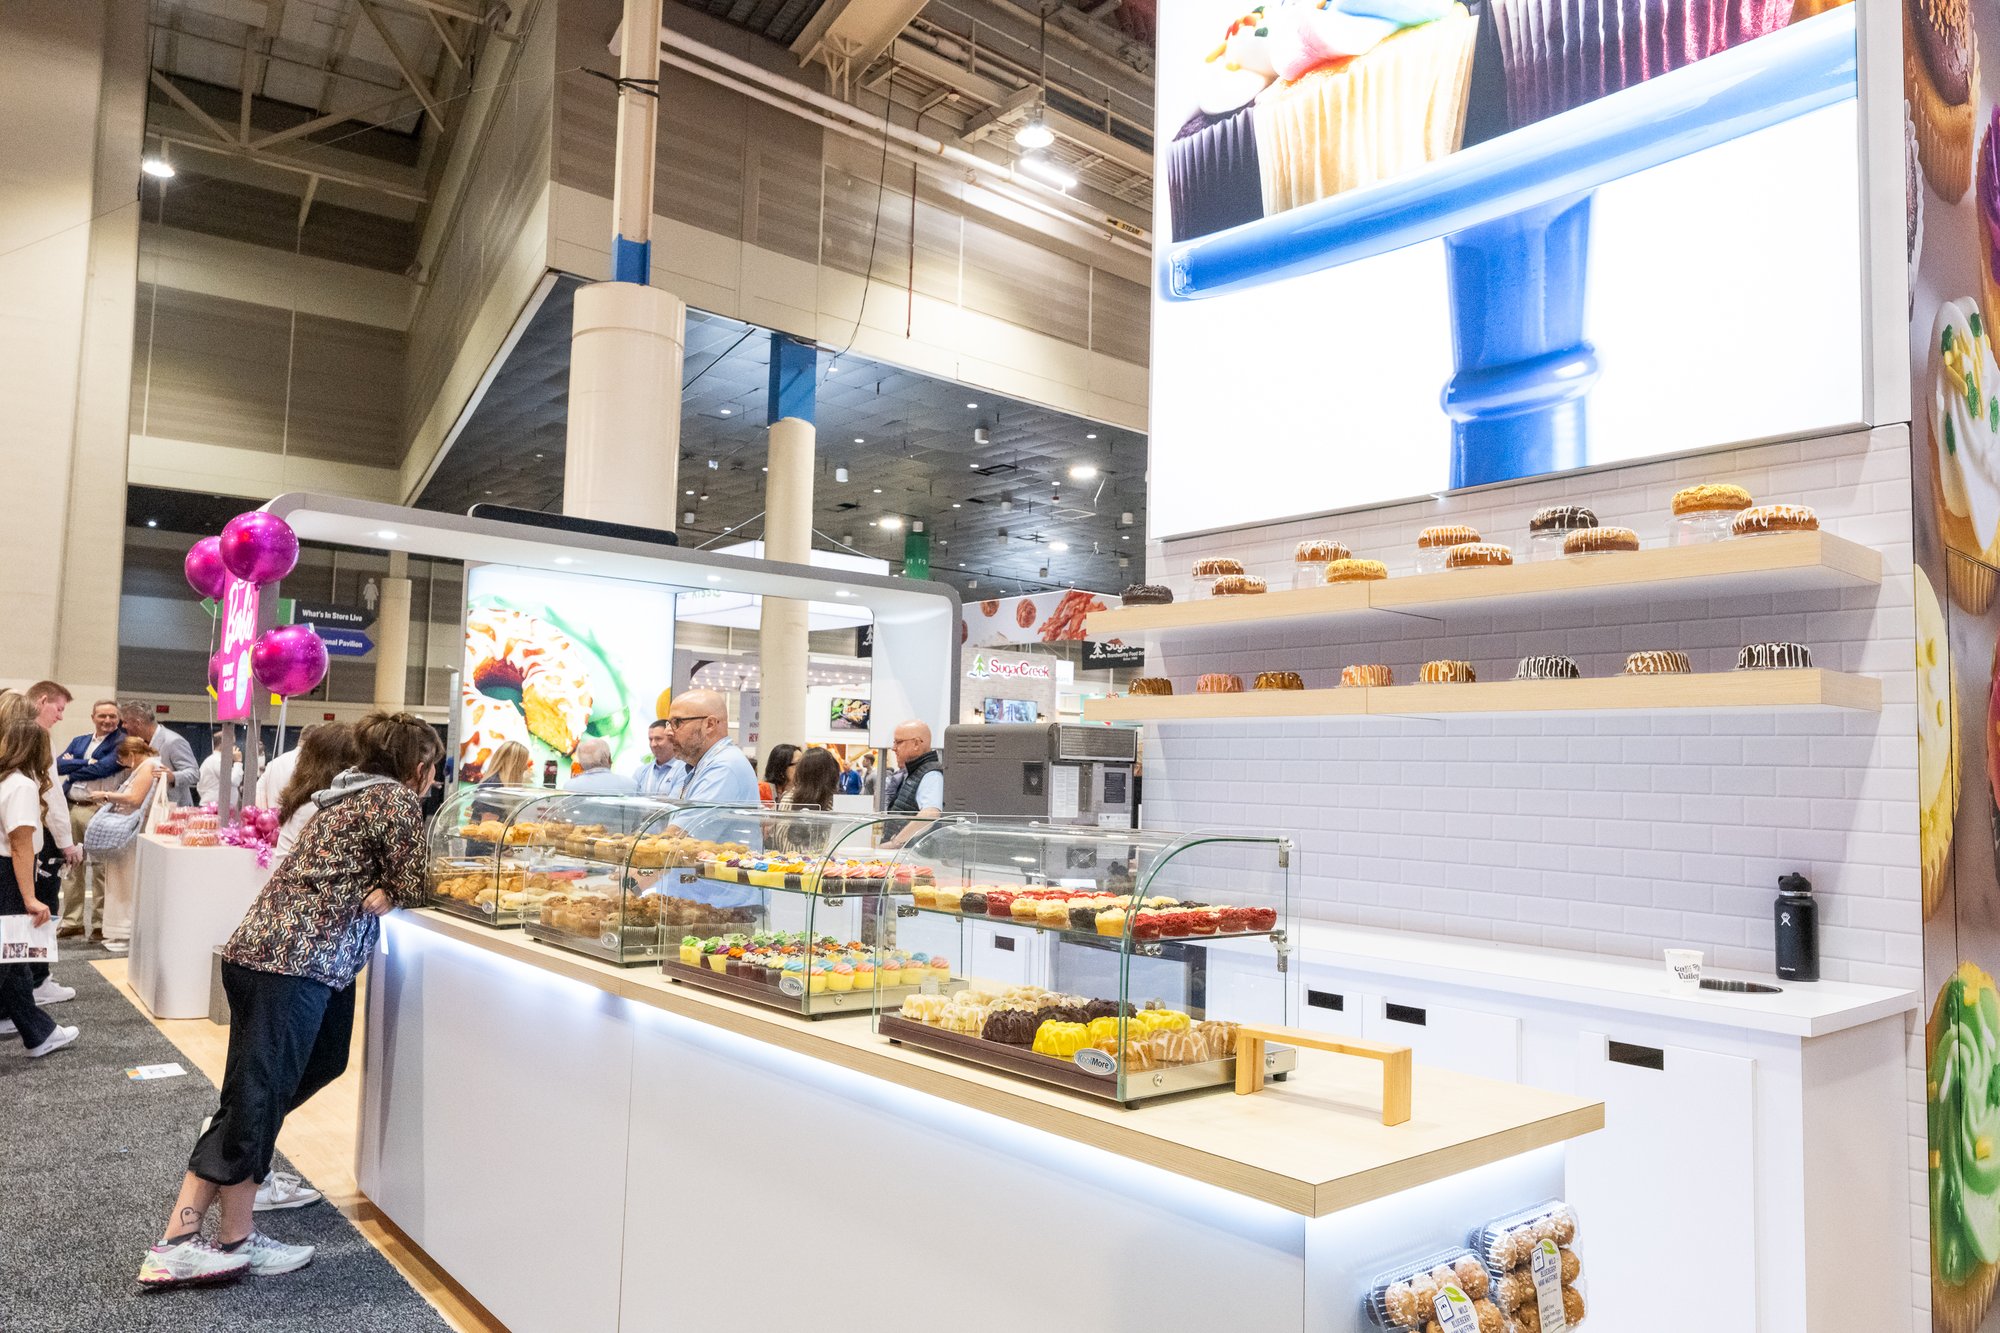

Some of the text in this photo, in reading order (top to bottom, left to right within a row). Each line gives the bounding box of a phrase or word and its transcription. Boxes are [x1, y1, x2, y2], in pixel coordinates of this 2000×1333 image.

[1122, 223, 1140, 235] STEAM
[302, 609, 324, 618] What's
[332, 612, 349, 620] Store
[350, 613, 363, 622] Live
[339, 640, 363, 648] Pavilion
[991, 659, 1049, 677] SugarCreek
[1078, 1053, 1109, 1069] KoolMore
